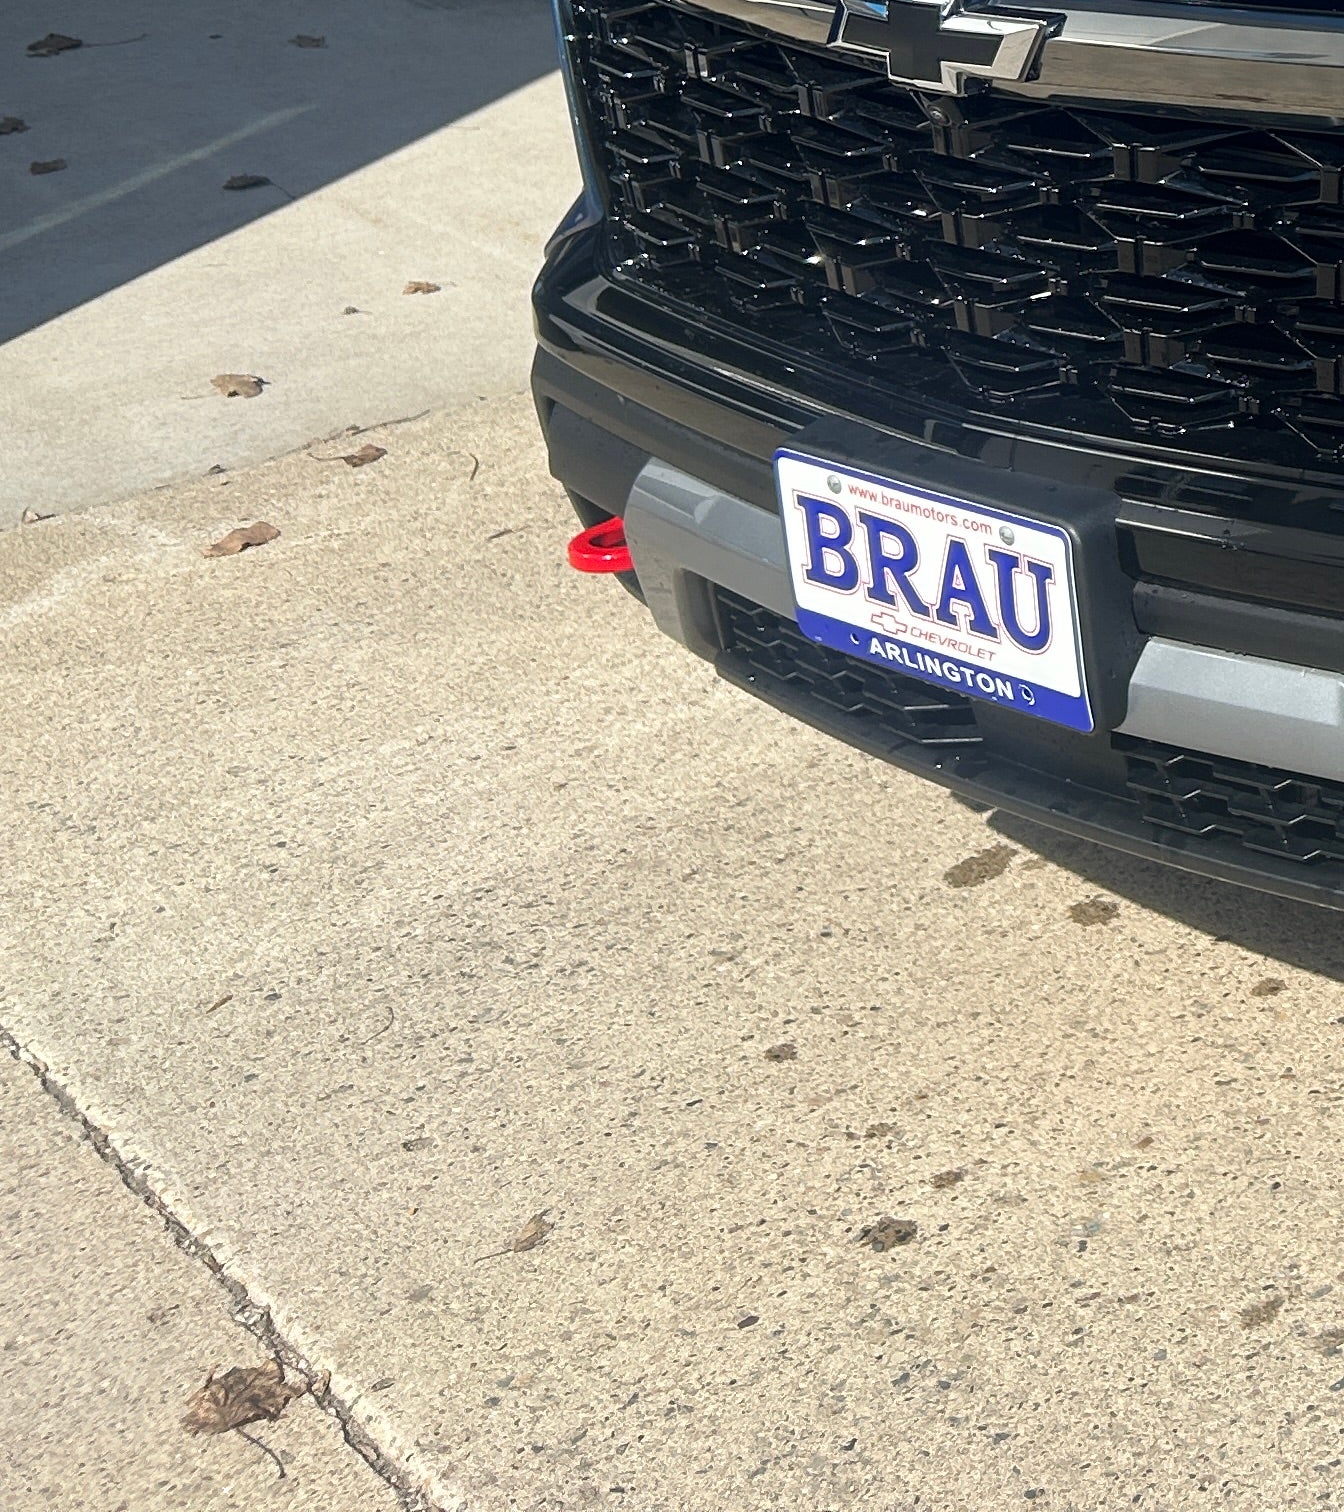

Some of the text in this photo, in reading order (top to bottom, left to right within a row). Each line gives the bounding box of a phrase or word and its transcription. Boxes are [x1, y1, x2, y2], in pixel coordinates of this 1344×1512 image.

[847, 483, 993, 536] www.braumotors.com
[792, 489, 1056, 657] BRAU
[869, 636, 1015, 701] ARLINGTON
[909, 626, 997, 662] CHEVROLET
